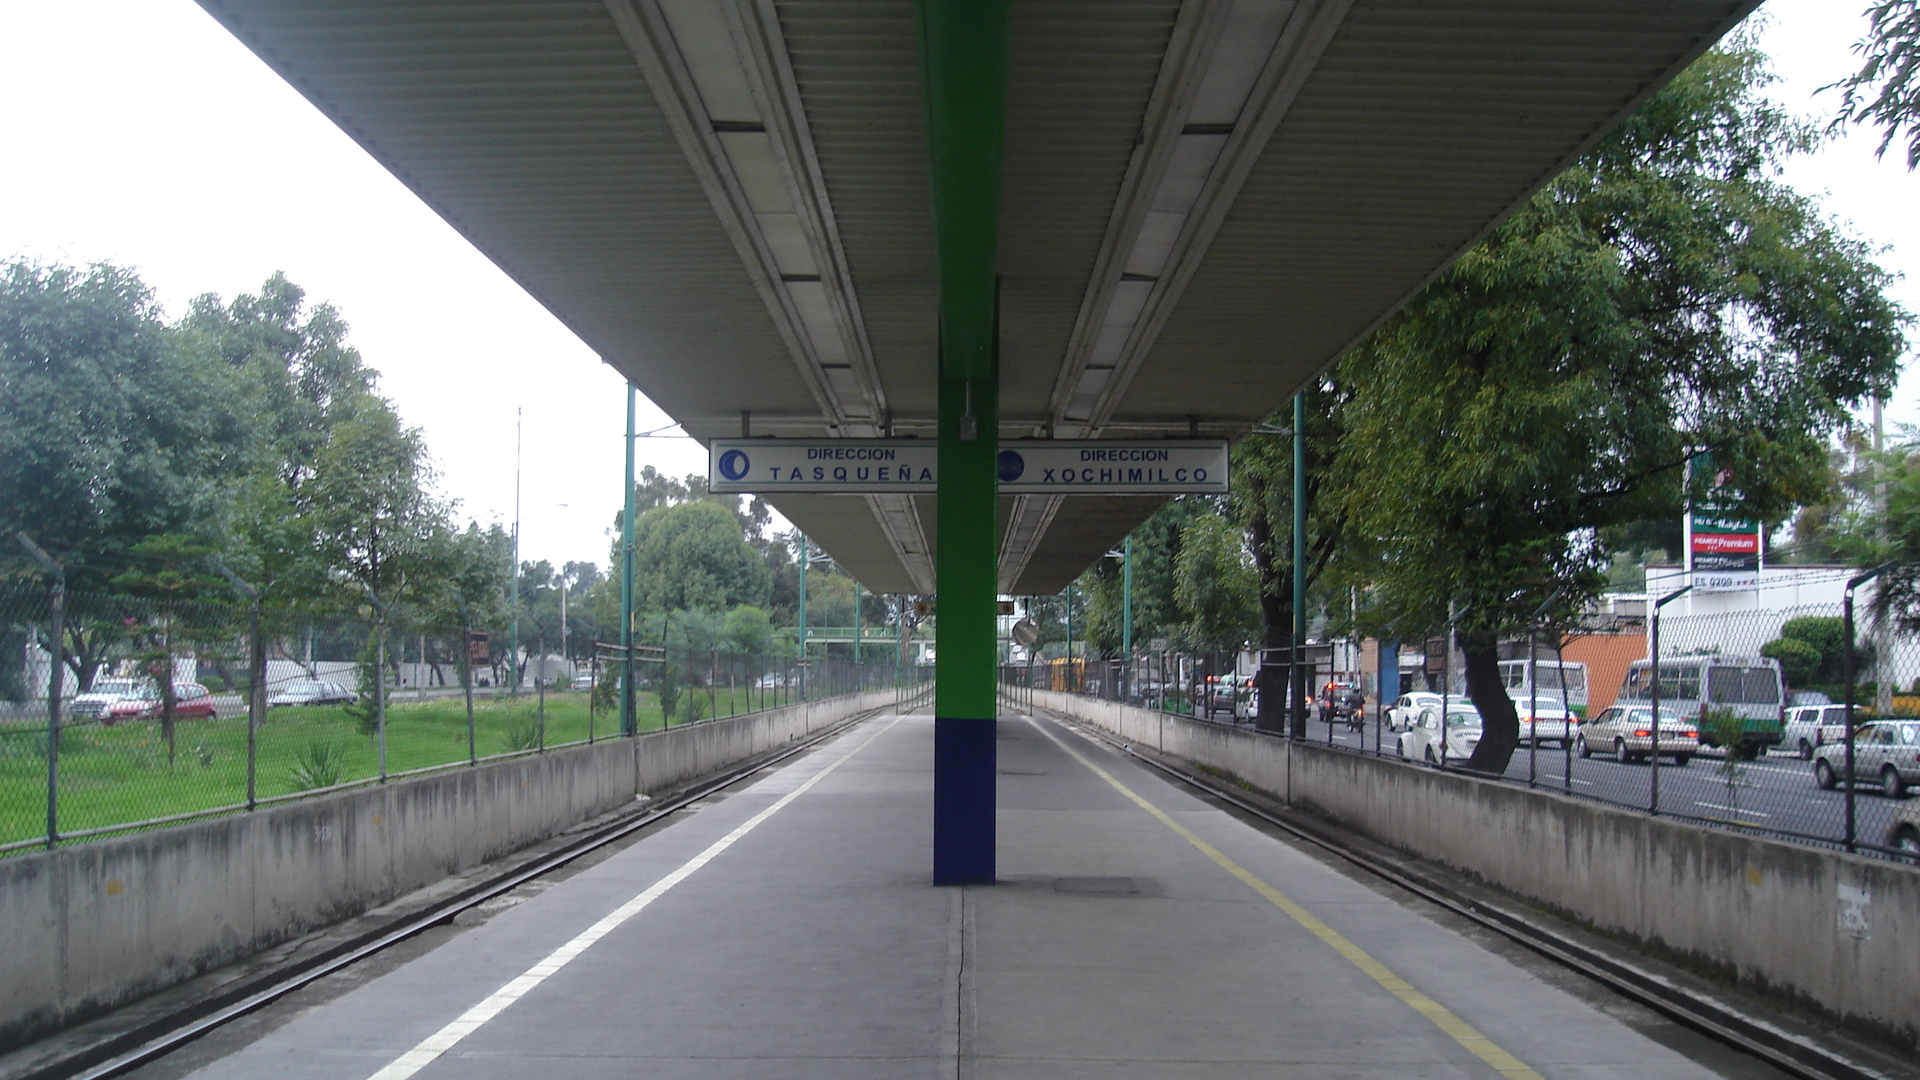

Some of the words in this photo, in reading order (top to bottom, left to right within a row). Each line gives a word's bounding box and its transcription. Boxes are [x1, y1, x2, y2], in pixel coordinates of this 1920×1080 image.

[808, 449, 895, 460] DIRECCION
[1081, 450, 1168, 461] DIRECCION
[769, 464, 933, 481] TASQUEÑA
[1043, 468, 1208, 482] XOCHIMILCO
[1718, 538, 1753, 548] Premium
